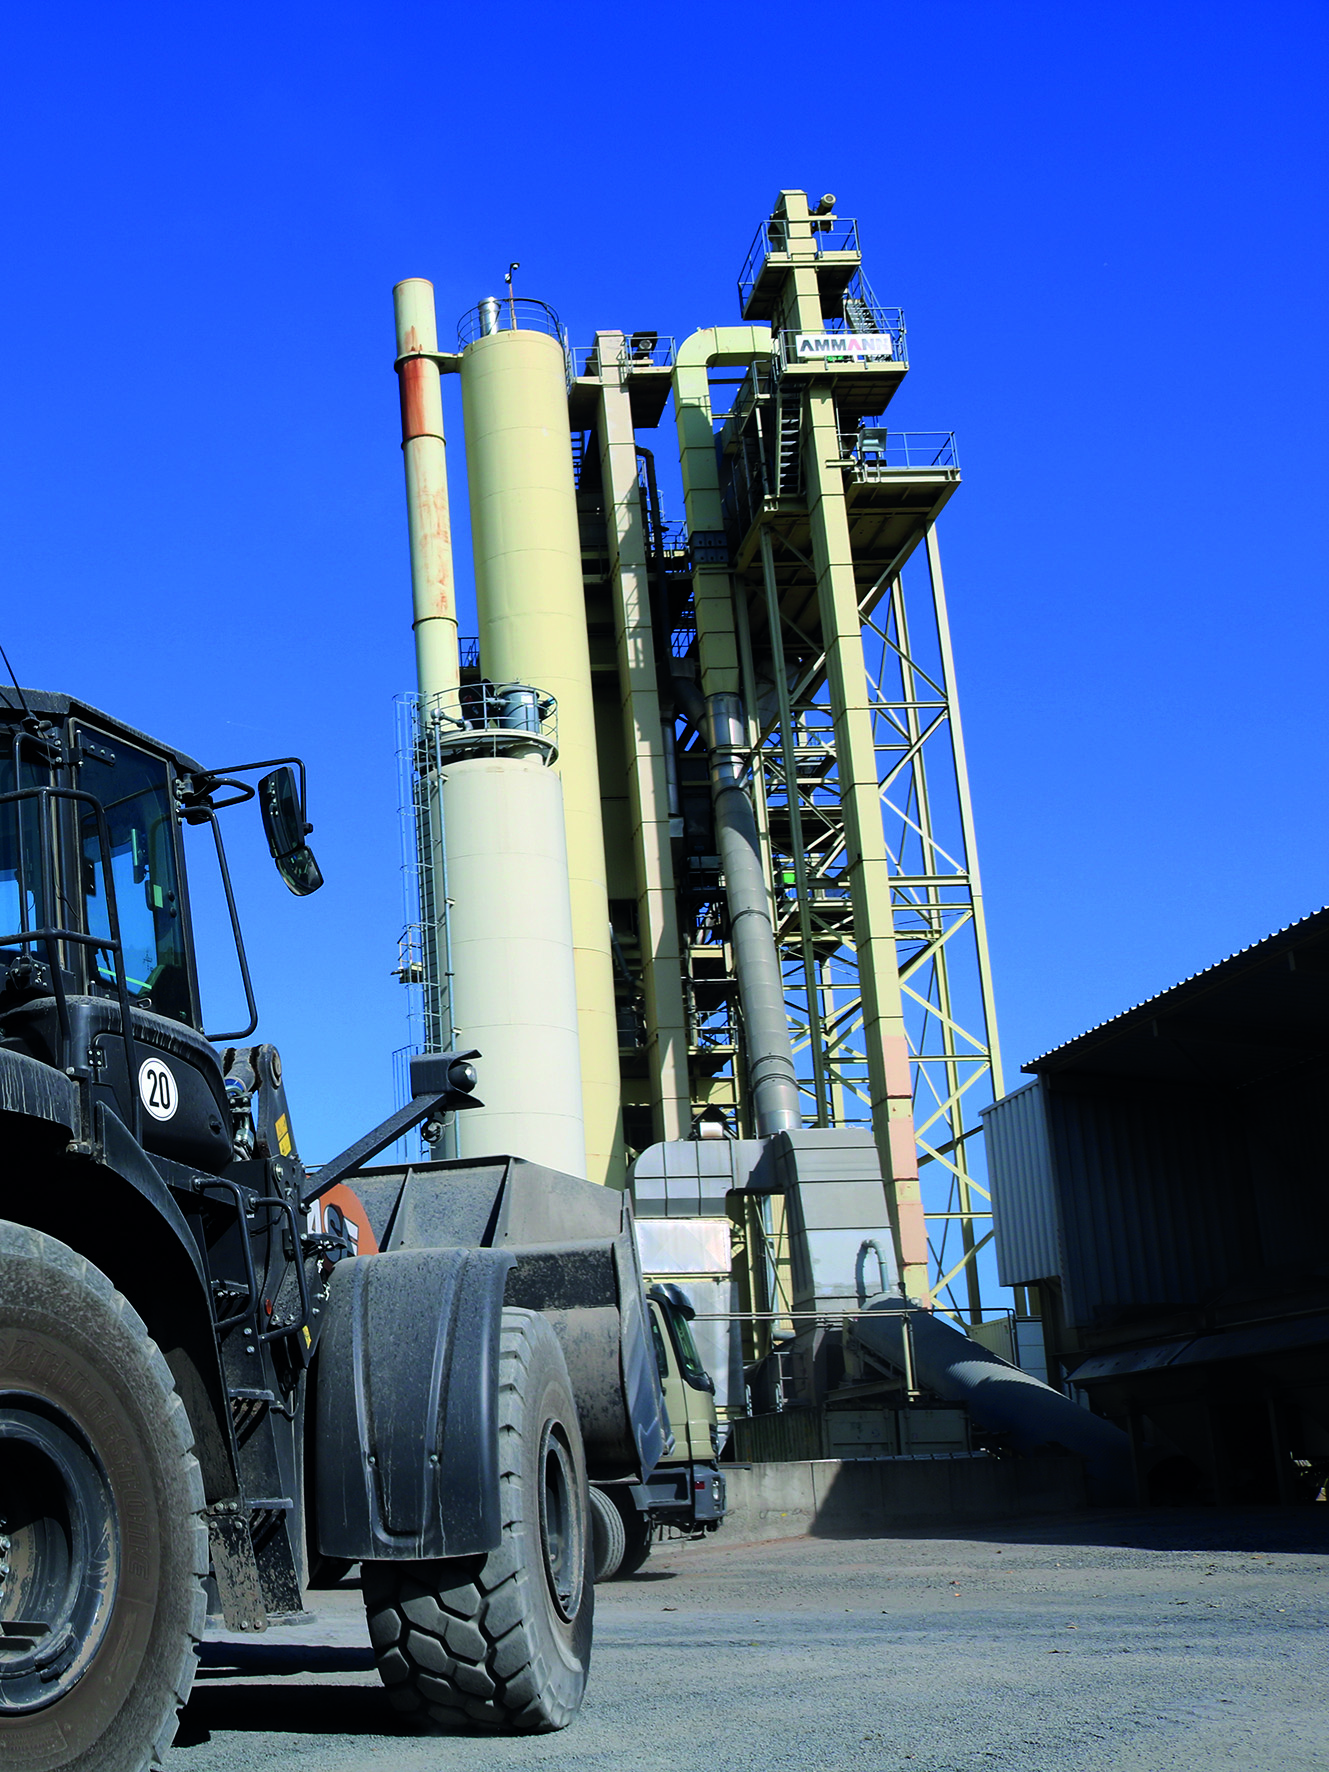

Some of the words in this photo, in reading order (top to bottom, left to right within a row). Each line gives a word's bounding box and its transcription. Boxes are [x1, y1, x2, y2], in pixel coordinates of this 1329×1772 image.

[799, 338, 889, 352] AMMANN
[147, 1069, 170, 1109] 20
[306, 1198, 359, 1263] ASE
[3, 1339, 151, 1582] BRIDGESTONE
